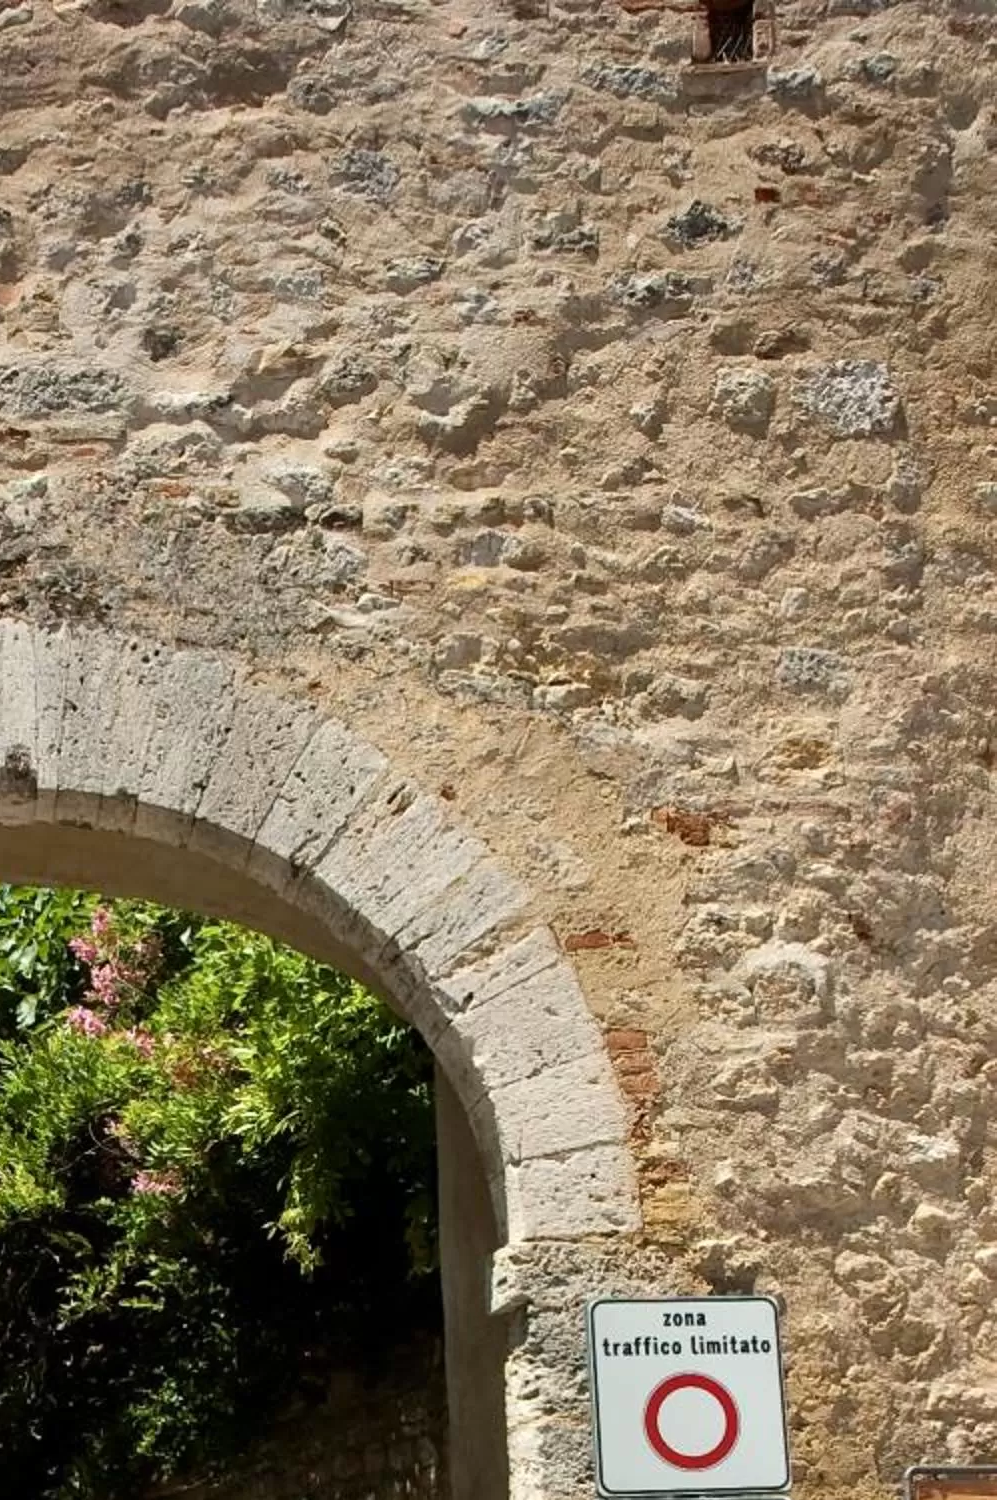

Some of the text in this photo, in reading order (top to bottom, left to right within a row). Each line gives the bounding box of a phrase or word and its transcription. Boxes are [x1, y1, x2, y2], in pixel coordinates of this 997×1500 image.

[662, 1312, 707, 1327] zona
[602, 1335, 771, 1356] traffico limitato
